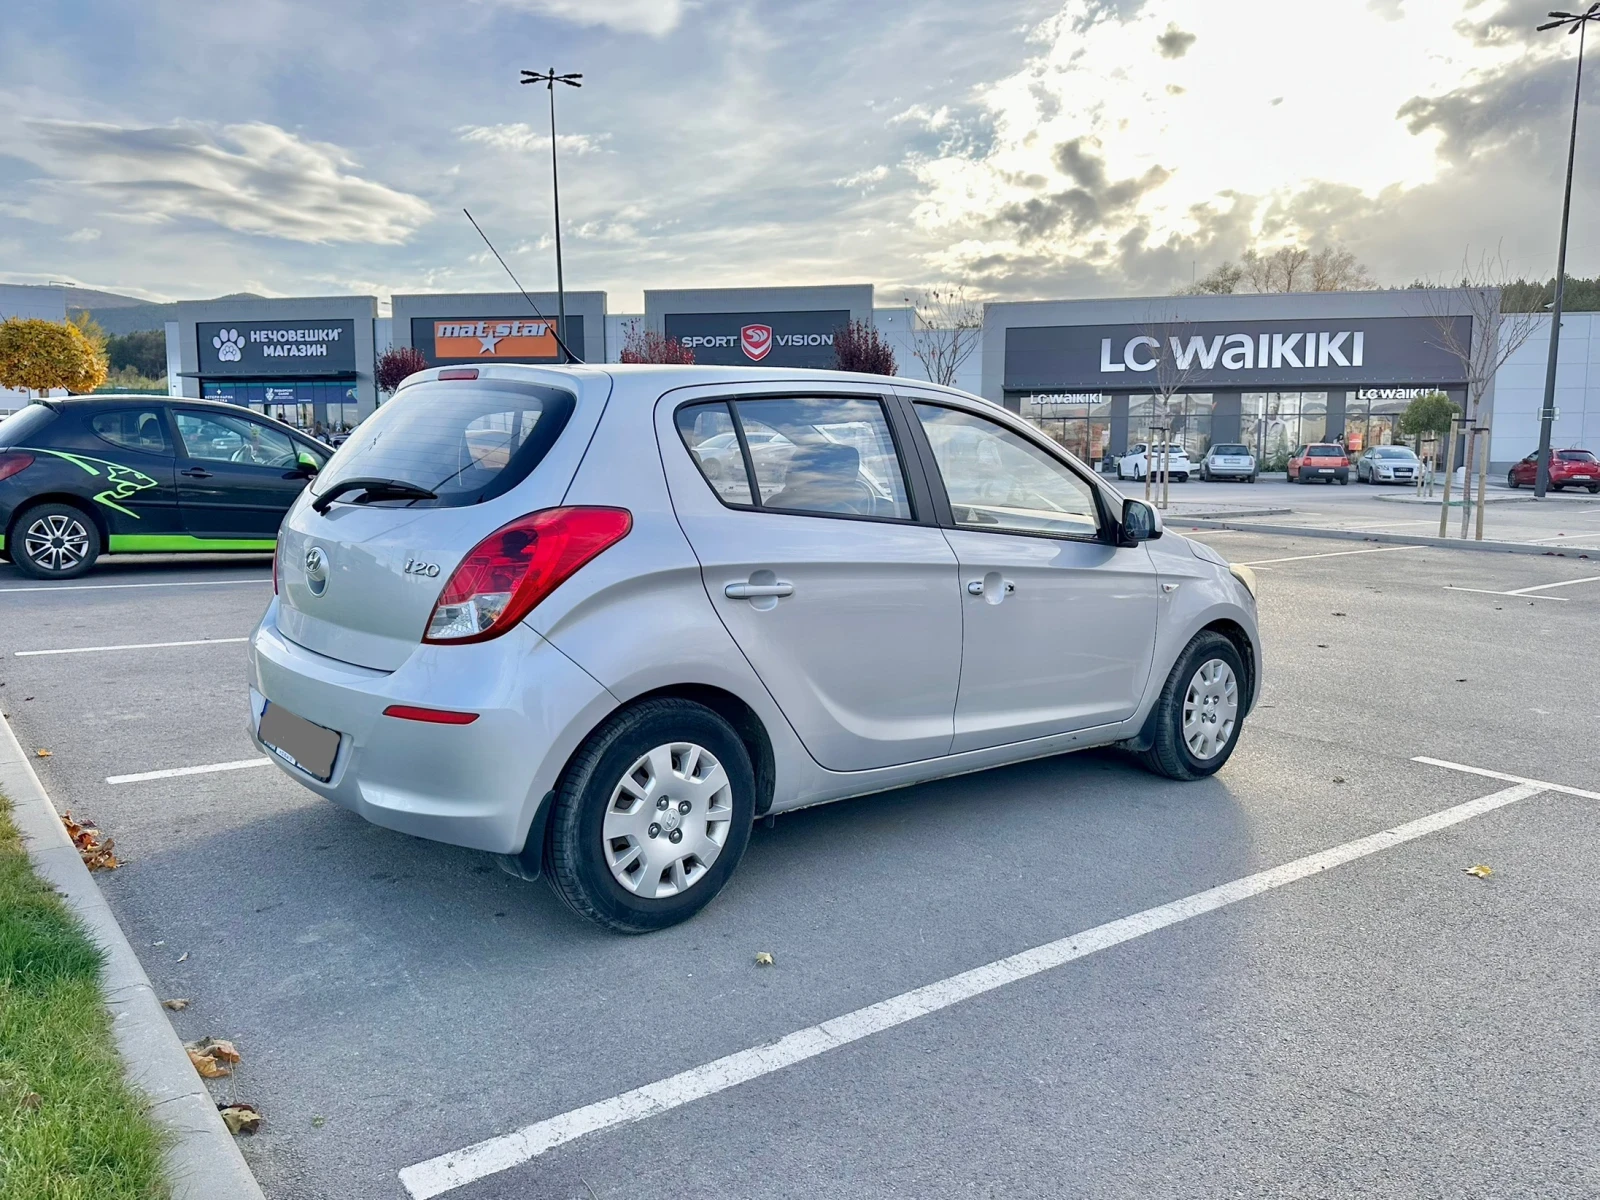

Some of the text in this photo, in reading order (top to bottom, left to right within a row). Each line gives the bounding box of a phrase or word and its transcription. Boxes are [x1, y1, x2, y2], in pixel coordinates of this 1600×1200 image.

[250, 328, 340, 343] НЕЧОВЕШКИ
[681, 334, 834, 348] SPORT VISION
[263, 344, 327, 357] МАГАЗИН
[1100, 335, 1161, 373] LC
[1030, 394, 1048, 405] LC
[1359, 388, 1379, 400] LC
[404, 558, 441, 578] i20
